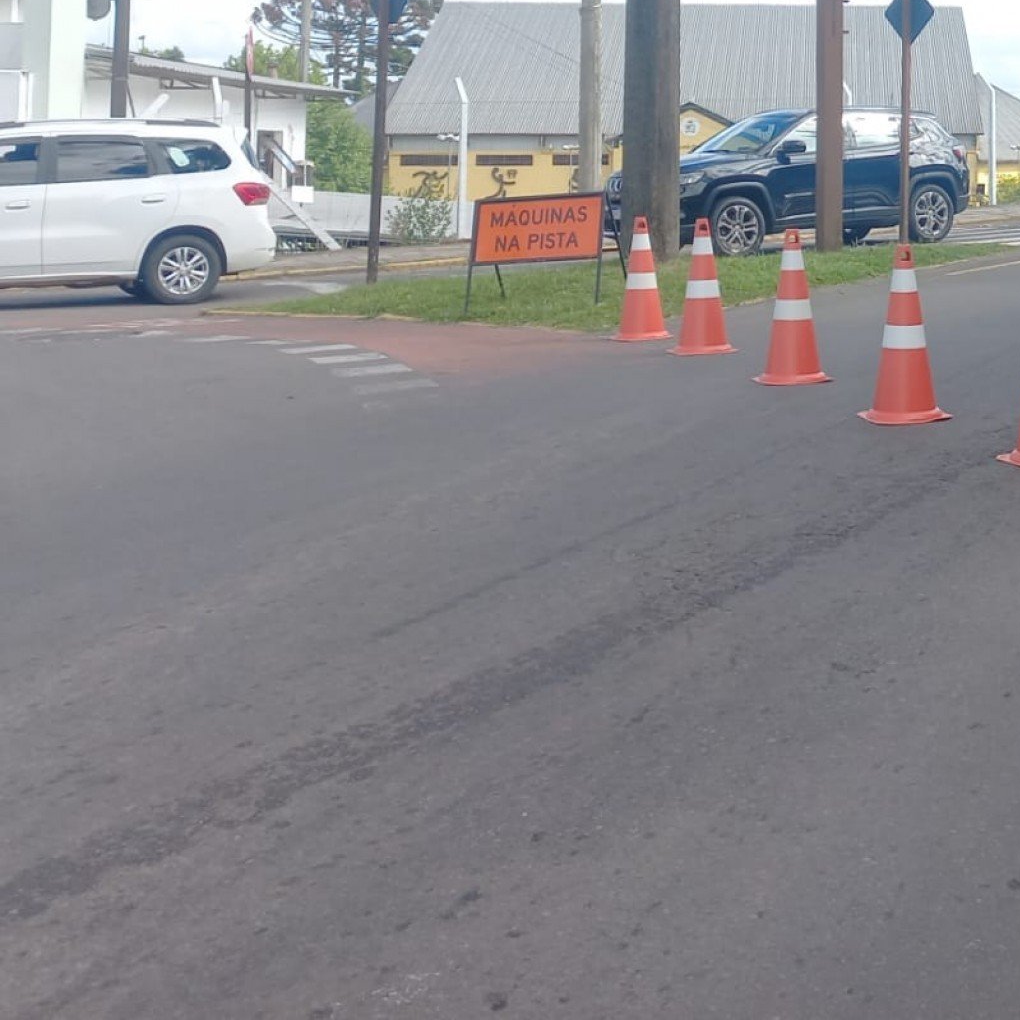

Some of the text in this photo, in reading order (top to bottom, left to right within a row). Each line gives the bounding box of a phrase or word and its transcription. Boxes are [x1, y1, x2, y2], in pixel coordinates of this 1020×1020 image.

[490, 205, 588, 228] MÁQUINAS
[495, 232, 579, 253] NA PISTA
